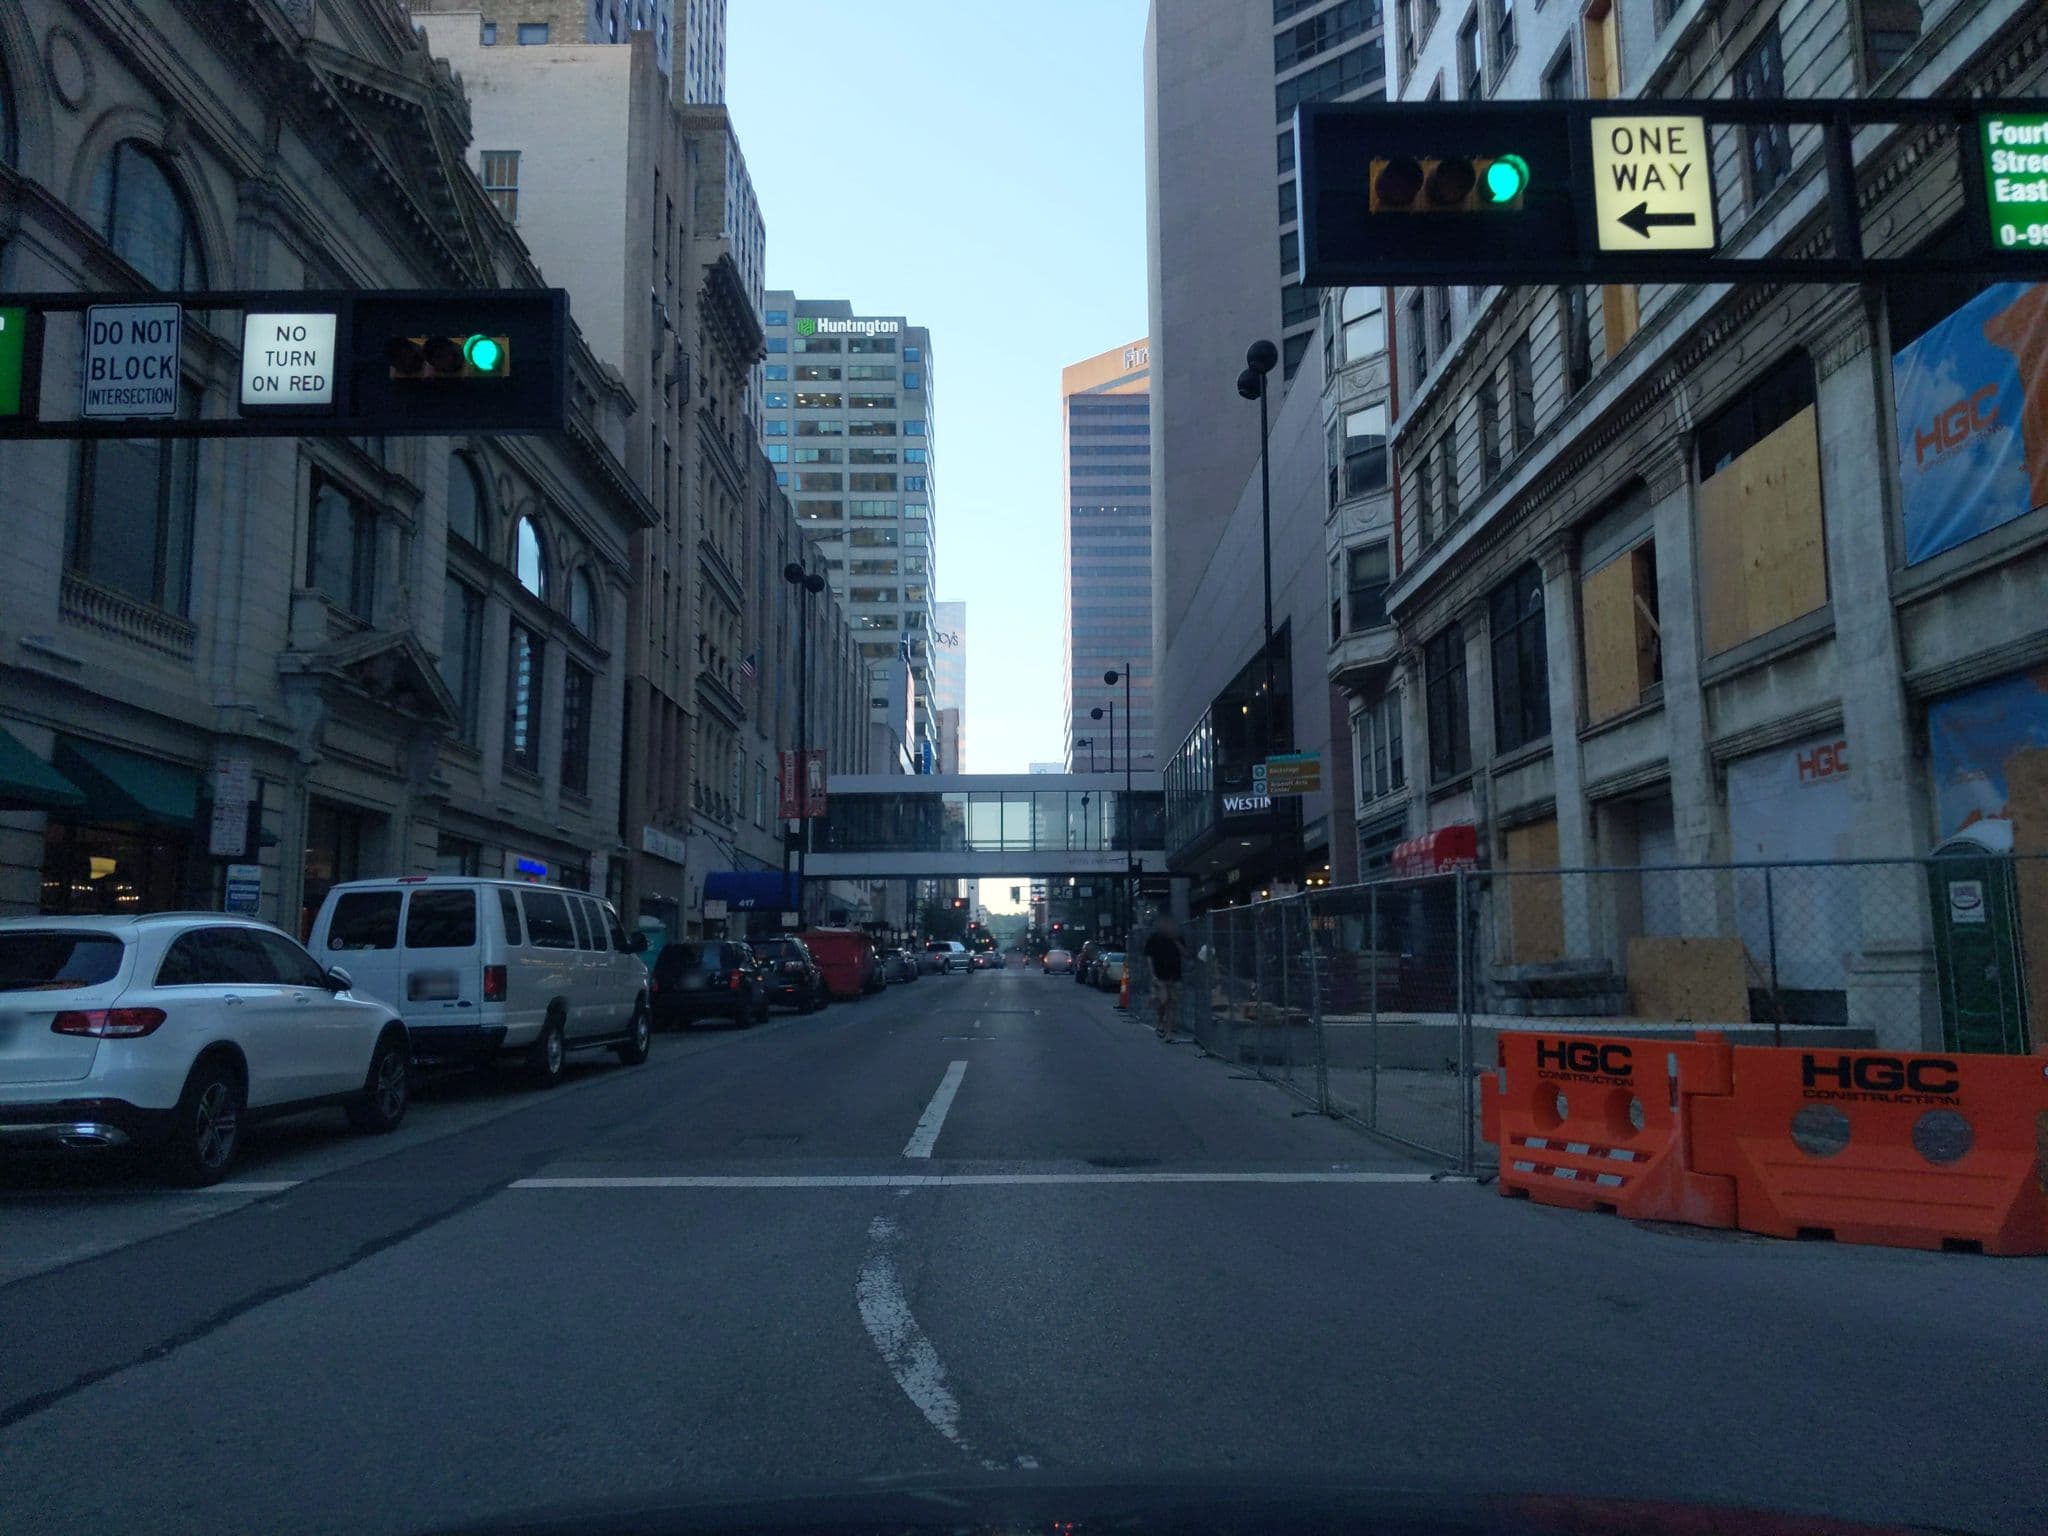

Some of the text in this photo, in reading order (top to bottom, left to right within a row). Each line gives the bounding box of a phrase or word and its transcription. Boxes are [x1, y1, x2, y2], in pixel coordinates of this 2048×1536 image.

[1611, 127, 1687, 155] ONE
[1612, 163, 1692, 191] WAY
[1995, 178, 2048, 202] East
[93, 319, 176, 345] DO NOT
[276, 325, 306, 341] NO
[818, 317, 898, 336] Huntington
[91, 355, 173, 380] BLOCK
[265, 350, 316, 367] TURN
[252, 375, 325, 391] ON RED
[88, 386, 173, 405] INTERSECTION
[1915, 381, 1998, 466] HGC
[1797, 741, 1848, 781] HGC
[1536, 1039, 1632, 1075] HGC
[1538, 1070, 1634, 1087] CONSTRUCTION
[1802, 1054, 1960, 1093] HGC
[1803, 1089, 1961, 1105] CONSTRUCTION
